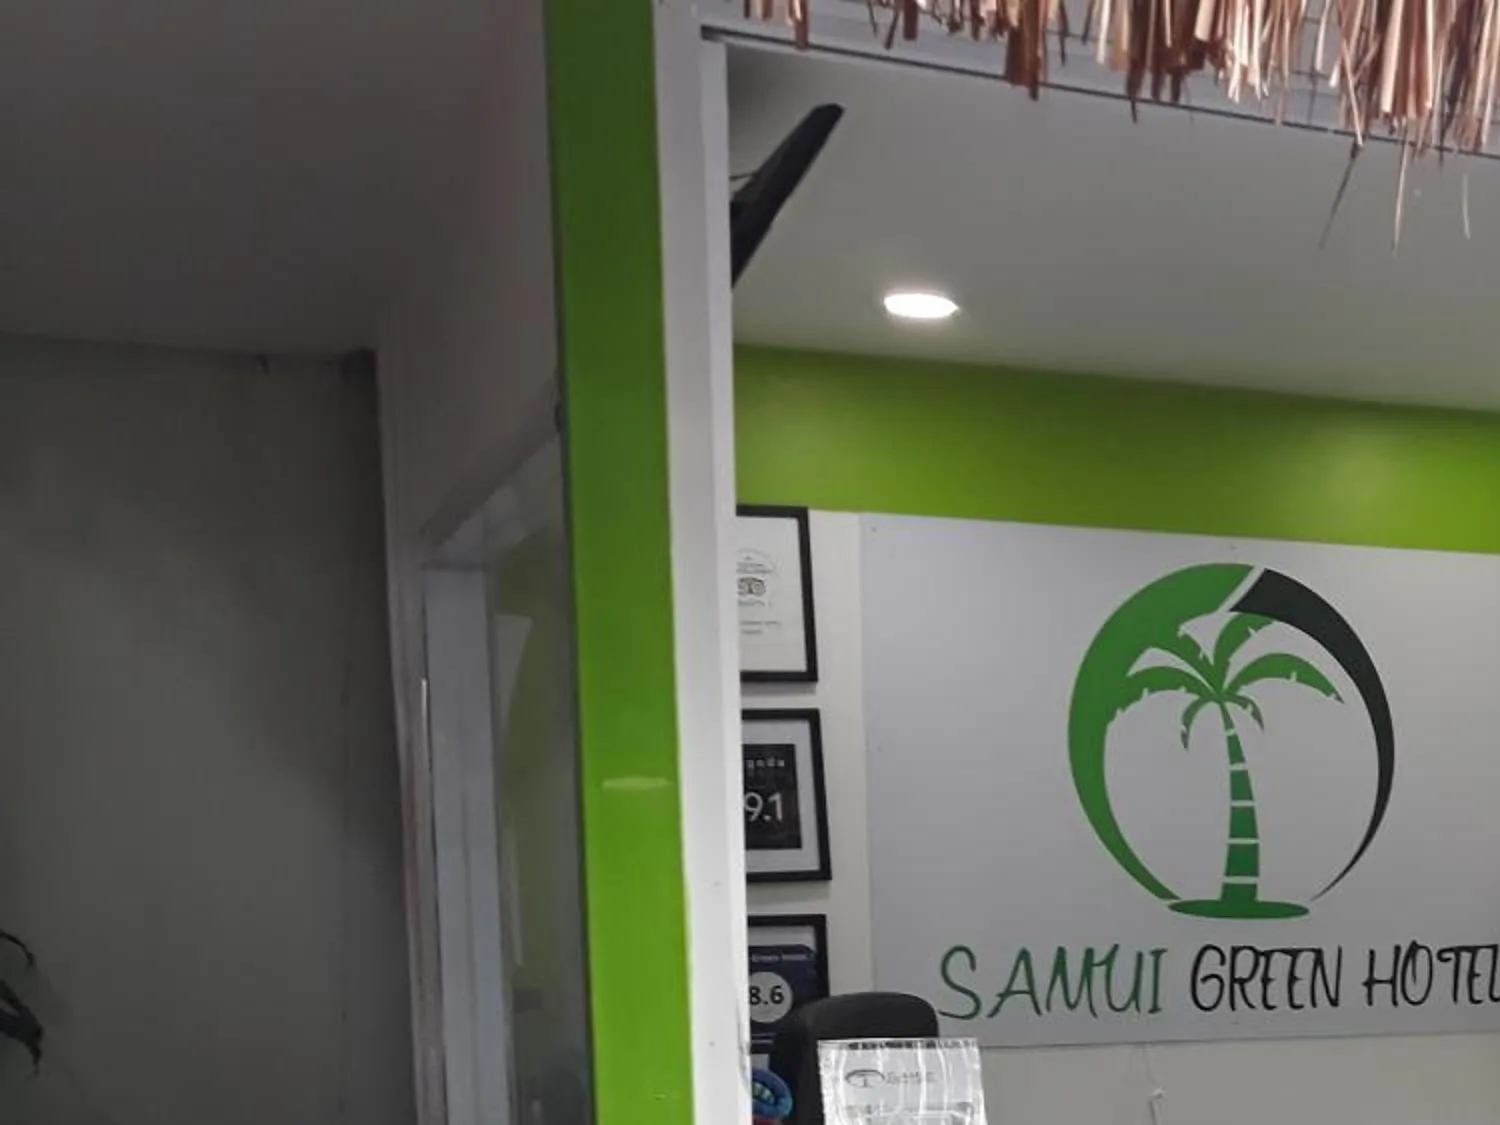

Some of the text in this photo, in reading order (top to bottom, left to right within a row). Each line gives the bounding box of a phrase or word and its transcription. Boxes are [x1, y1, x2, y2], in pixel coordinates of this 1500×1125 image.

[744, 791, 783, 822] 9.1
[749, 984, 785, 1006] 8.6
[939, 942, 1168, 1023] SAMUI
[1190, 943, 1344, 1013] GREEN
